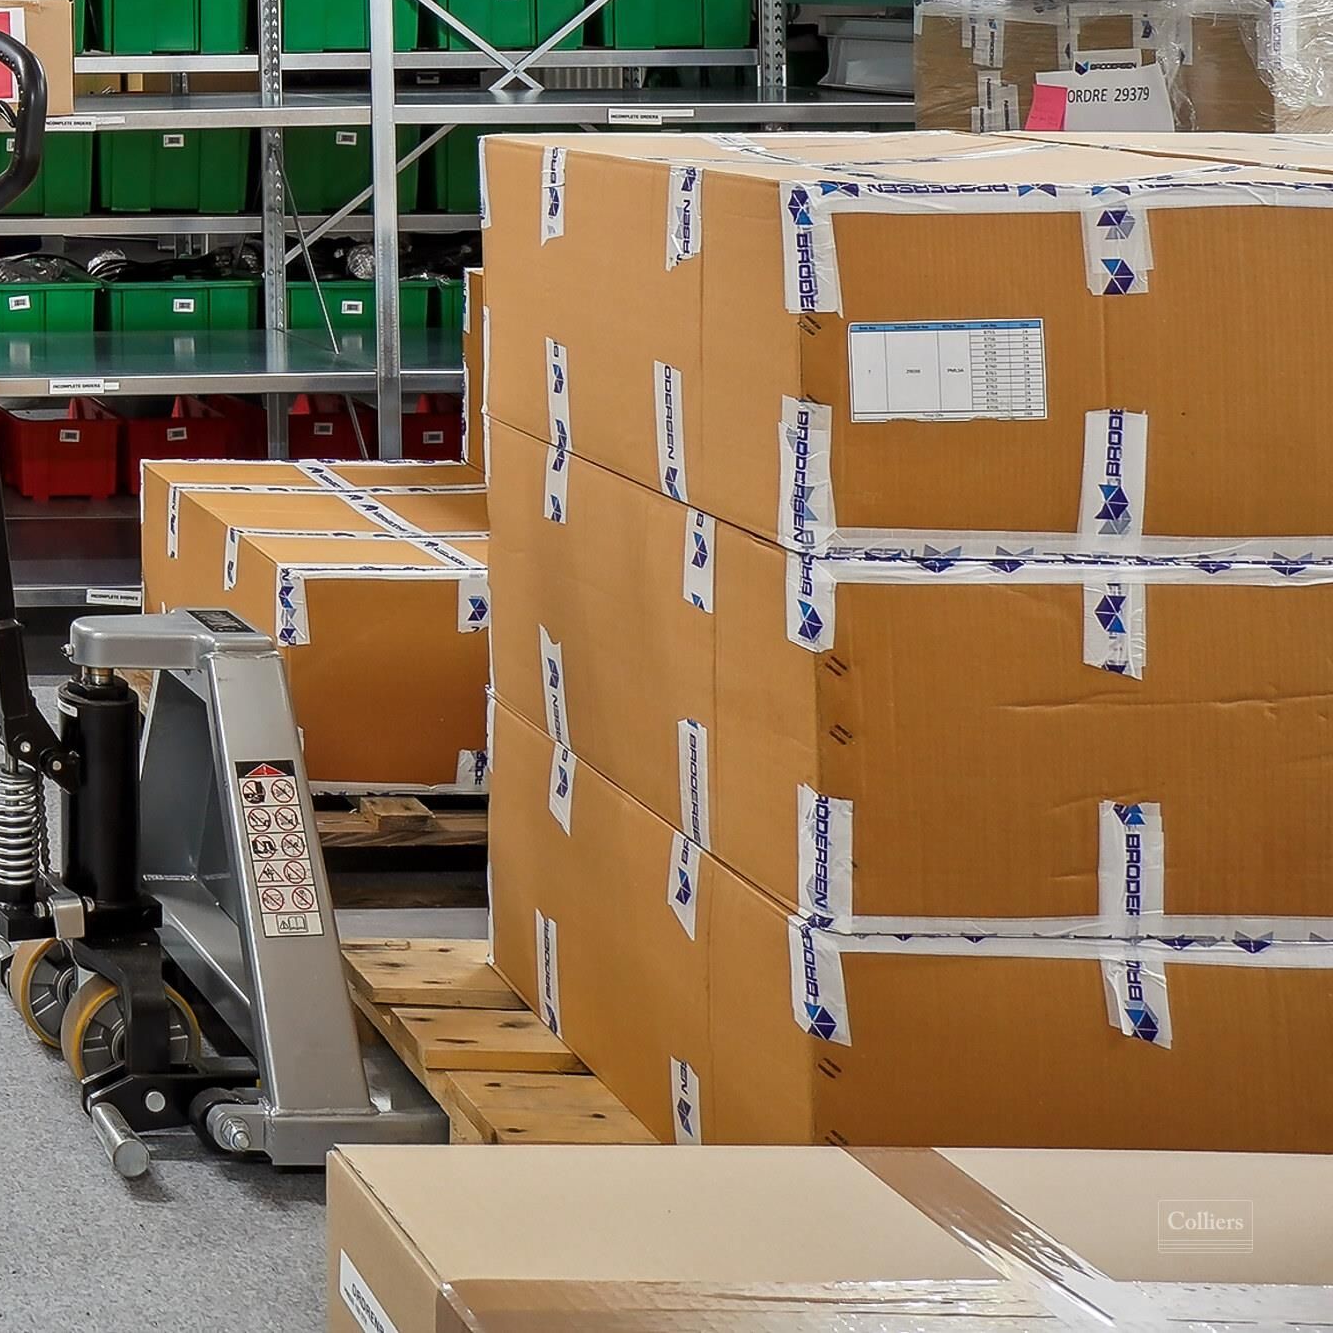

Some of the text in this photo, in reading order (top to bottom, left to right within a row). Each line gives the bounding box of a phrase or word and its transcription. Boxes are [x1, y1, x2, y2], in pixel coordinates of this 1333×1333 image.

[1089, 62, 1137, 71] BRODERSEN
[1067, 87, 1150, 103] ORDRE 29379
[796, 233, 815, 314] BRODE
[793, 410, 811, 541] BRODERSEN
